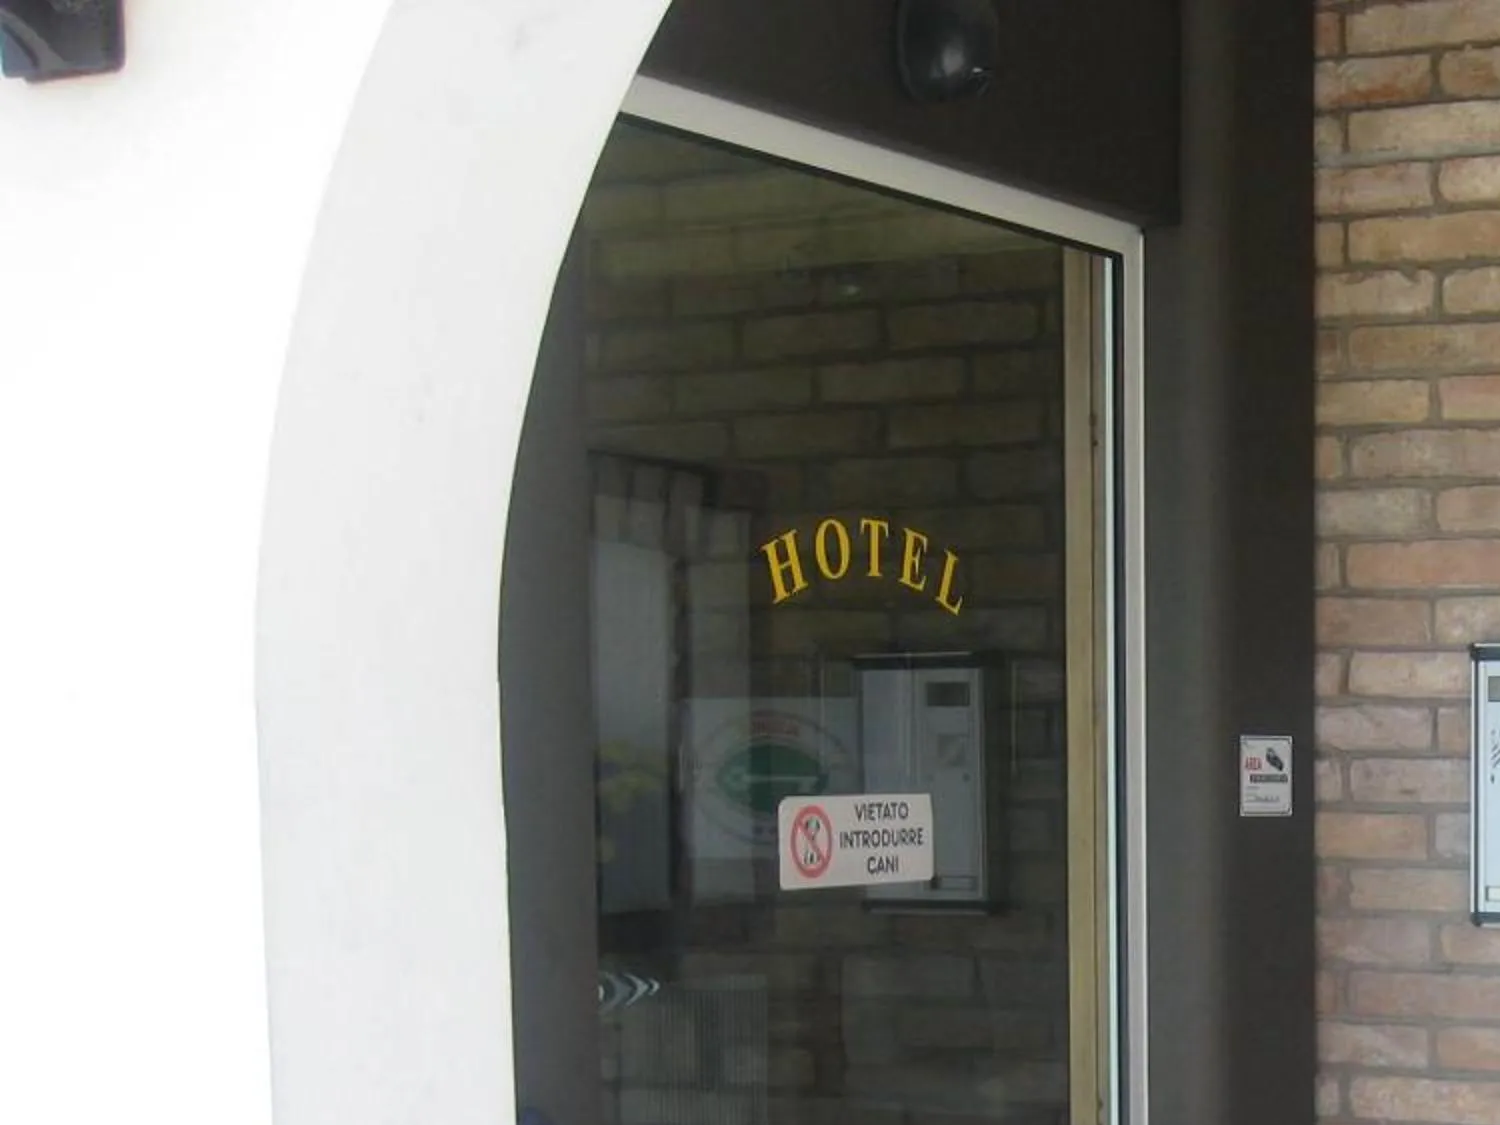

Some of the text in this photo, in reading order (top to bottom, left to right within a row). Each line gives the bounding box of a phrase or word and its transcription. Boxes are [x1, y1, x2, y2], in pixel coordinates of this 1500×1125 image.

[759, 517, 964, 616] HOTEL
[854, 802, 909, 822] VIETATO
[839, 827, 924, 849] INTRODURRE
[867, 855, 899, 875] CANI
